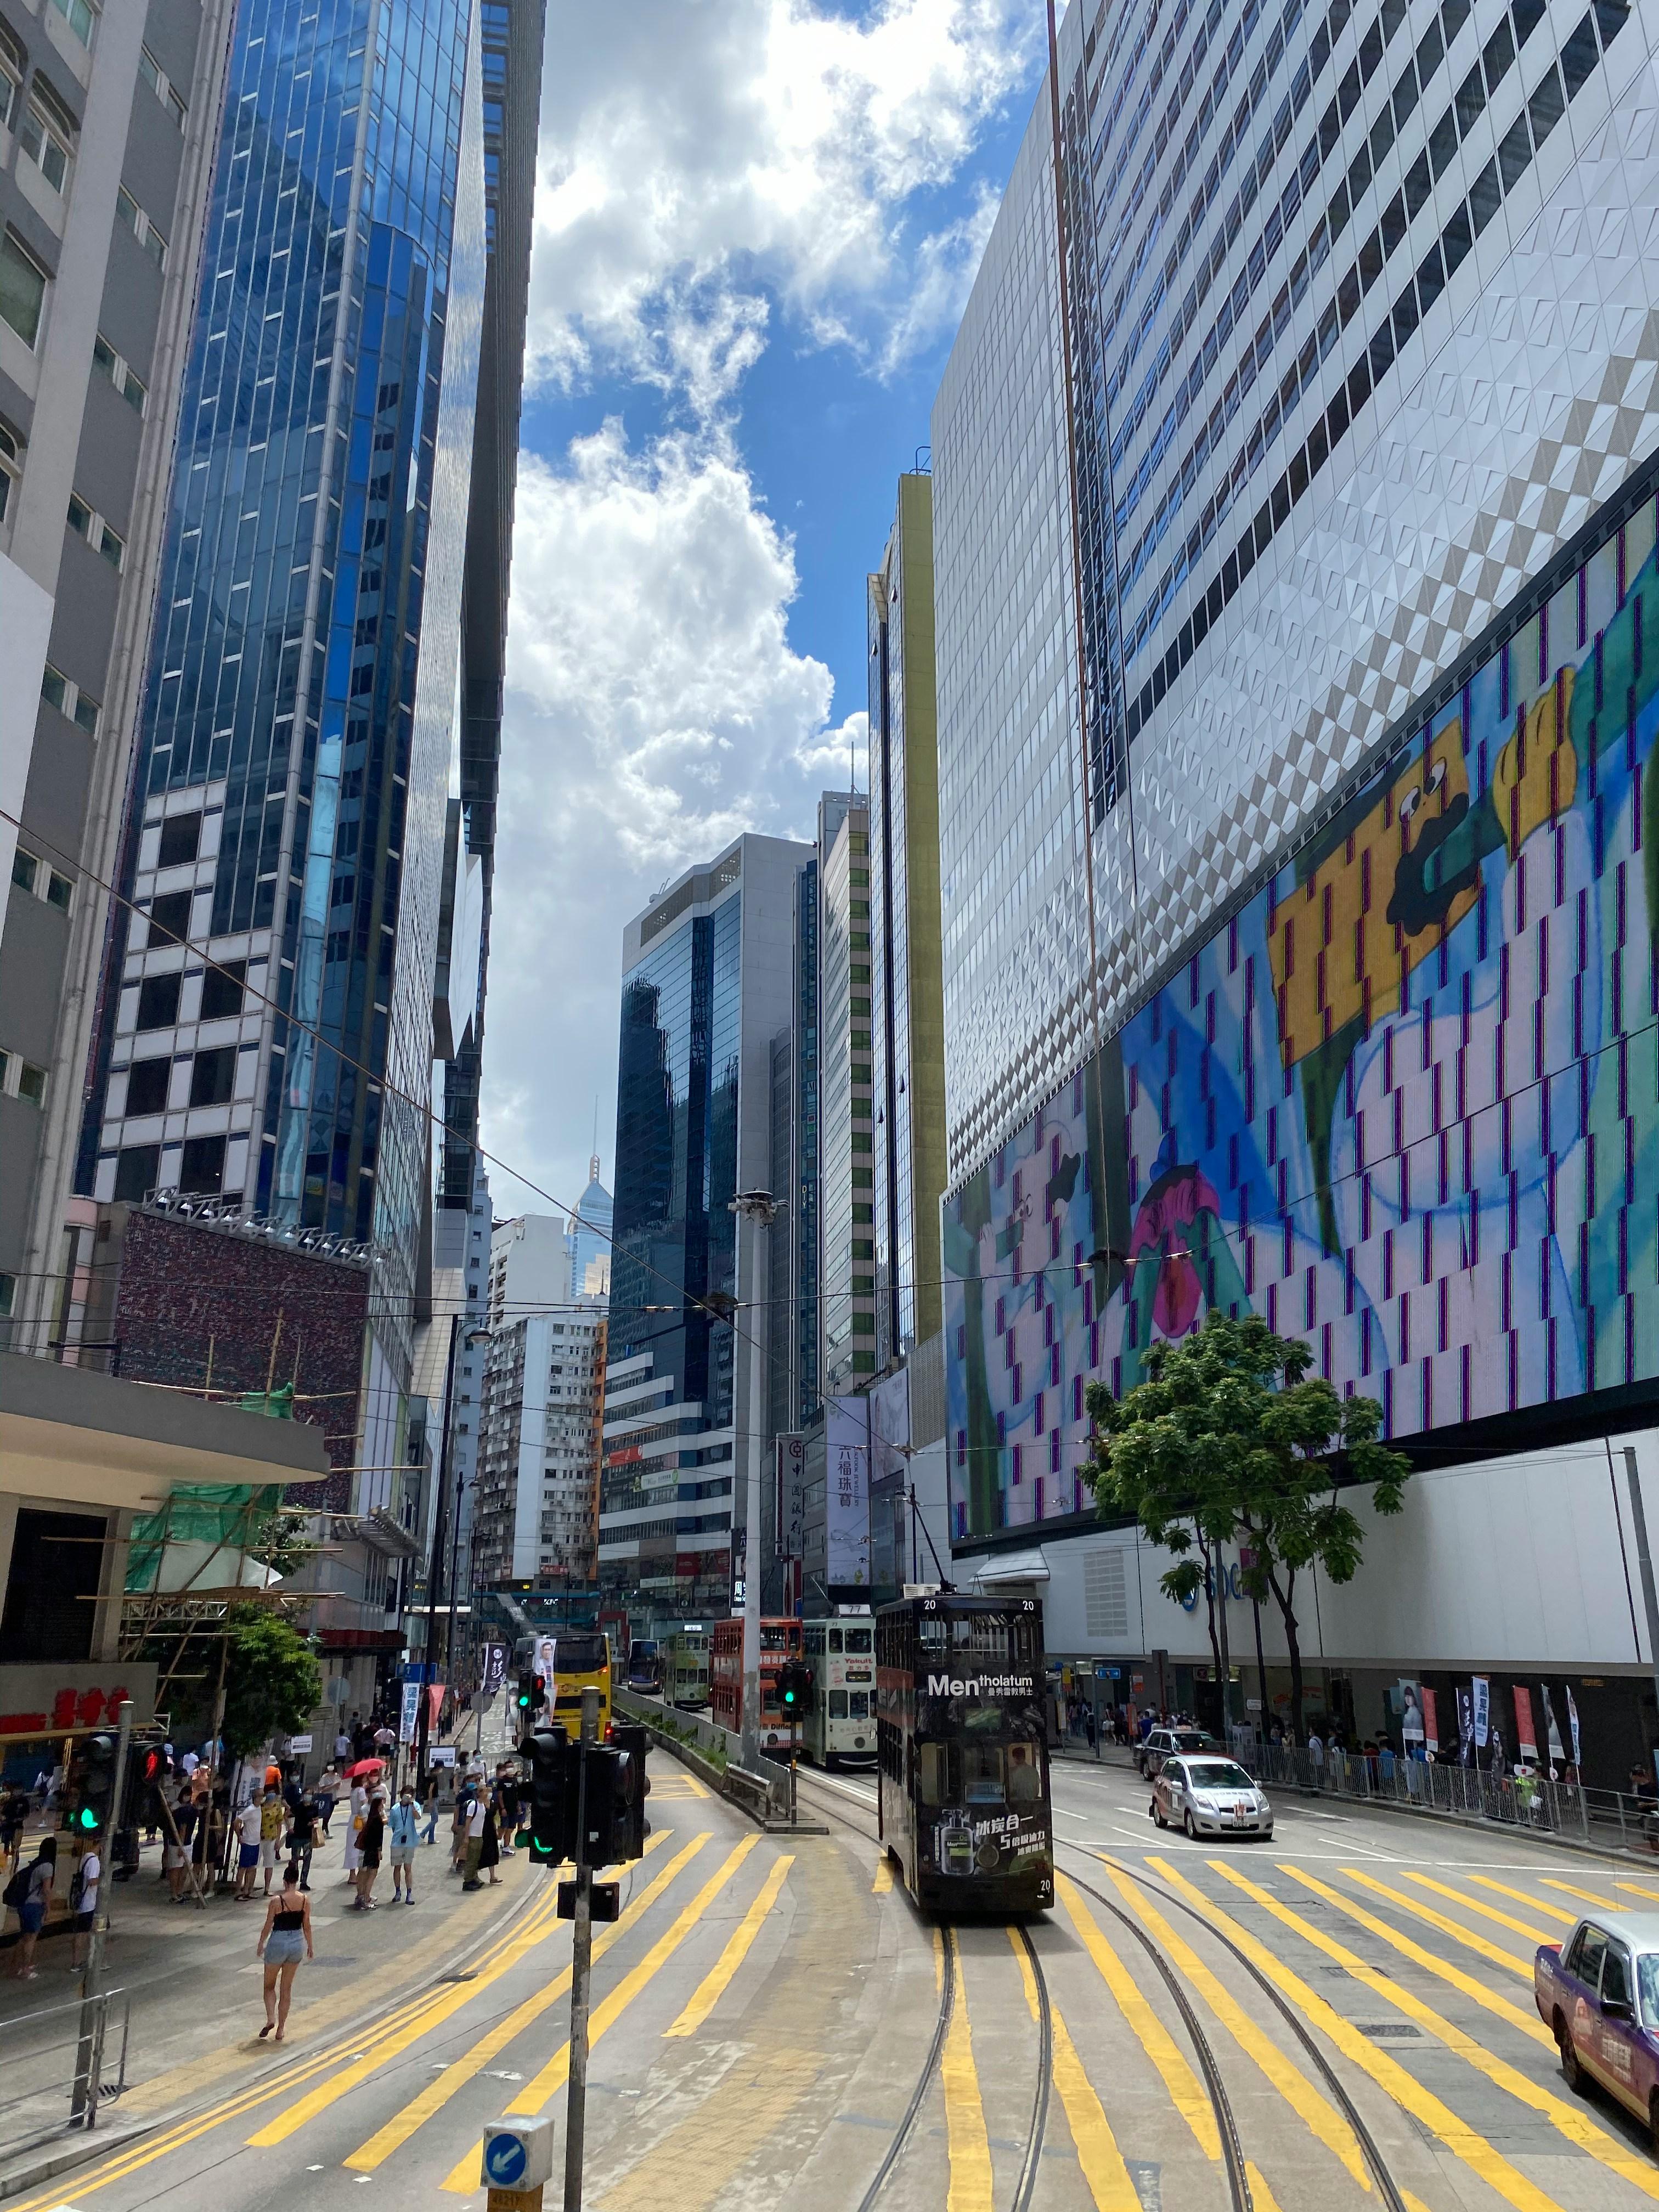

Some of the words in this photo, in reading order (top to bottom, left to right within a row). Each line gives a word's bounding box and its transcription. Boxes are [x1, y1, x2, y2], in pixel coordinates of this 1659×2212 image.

[837, 1446, 852, 1507] 六福珠寶
[848, 1605, 861, 1613] 77
[924, 1600, 936, 1610] 20
[1023, 1600, 1034, 1611] 20
[928, 1674, 1032, 1696] Mentholatum
[988, 1687, 1033, 1696] 曼秀雷敦男士
[975, 1814, 1034, 1836] 冰炭合一
[1040, 1879, 1051, 1891] 20
